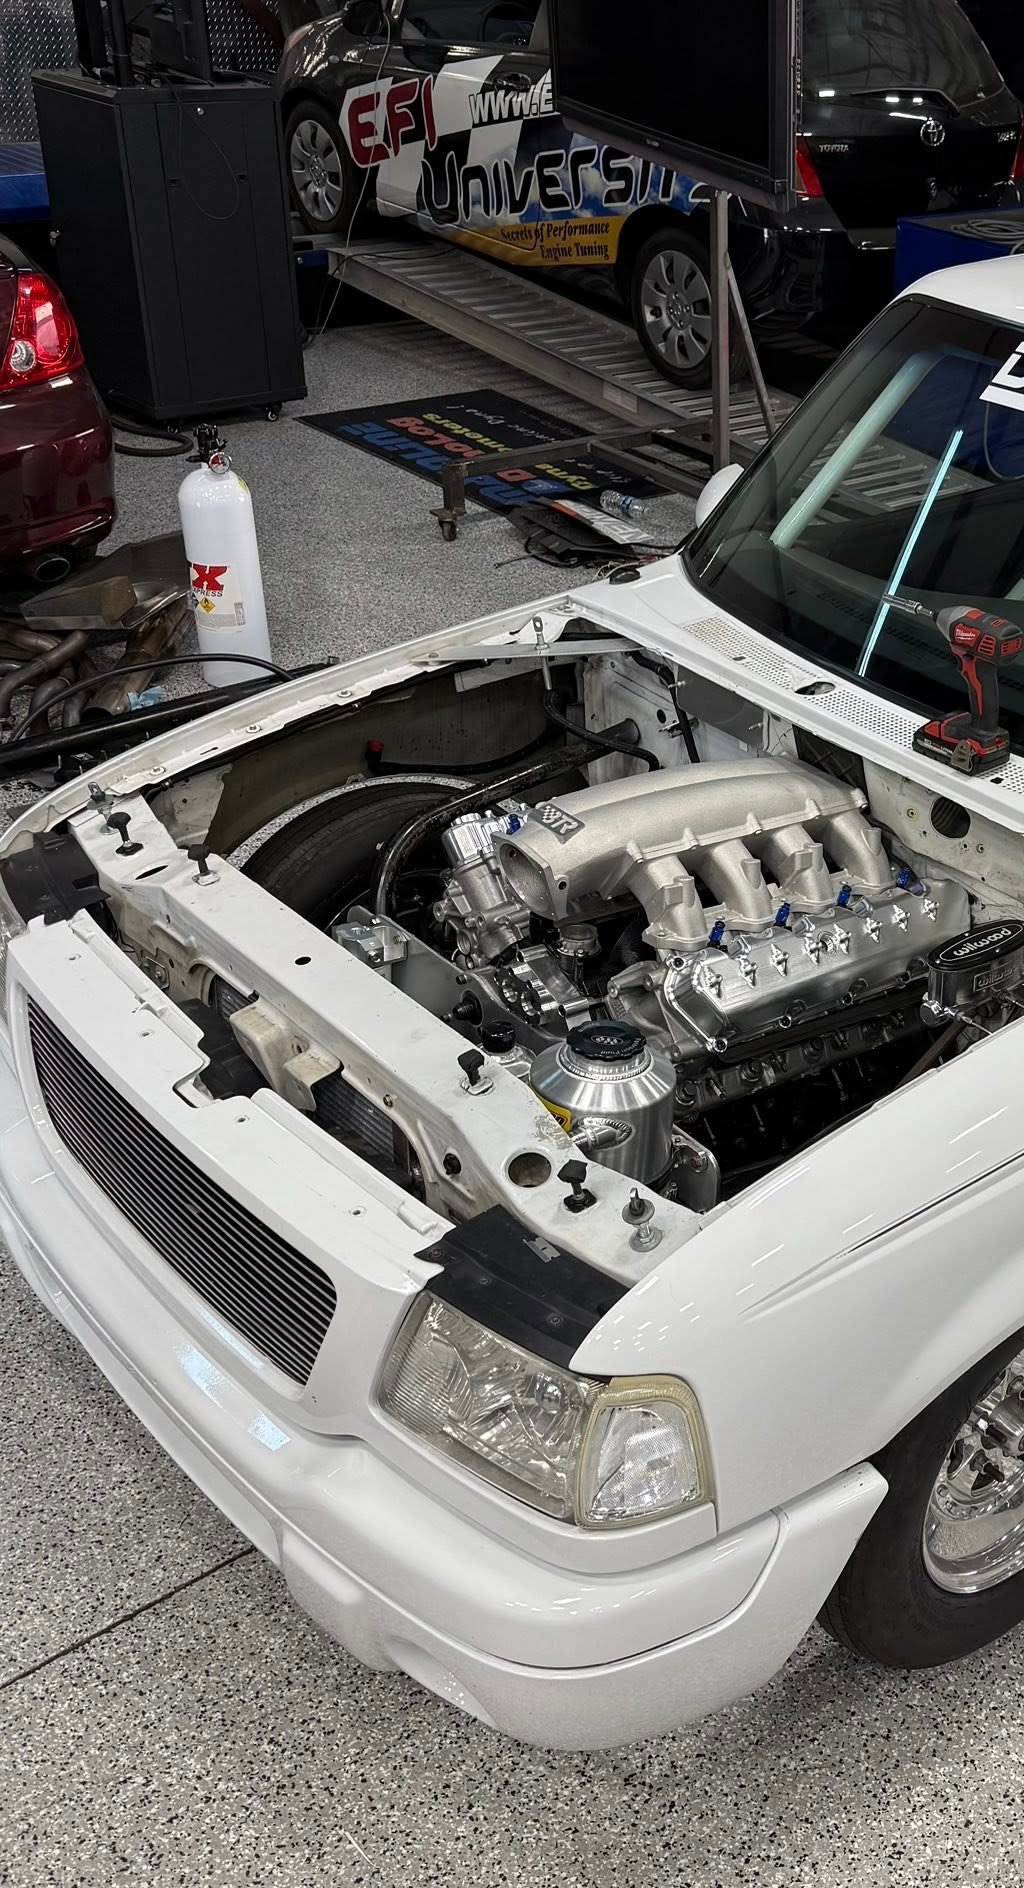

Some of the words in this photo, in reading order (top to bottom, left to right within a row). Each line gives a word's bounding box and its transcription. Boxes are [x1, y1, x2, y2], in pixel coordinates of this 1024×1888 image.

[348, 75, 438, 169] EFI
[818, 143, 849, 153] TOYOTA
[546, 221, 610, 240] Performance
[540, 244, 572, 262] Engine
[574, 241, 609, 259] Tuning
[952, 927, 1013, 957] wilwood
